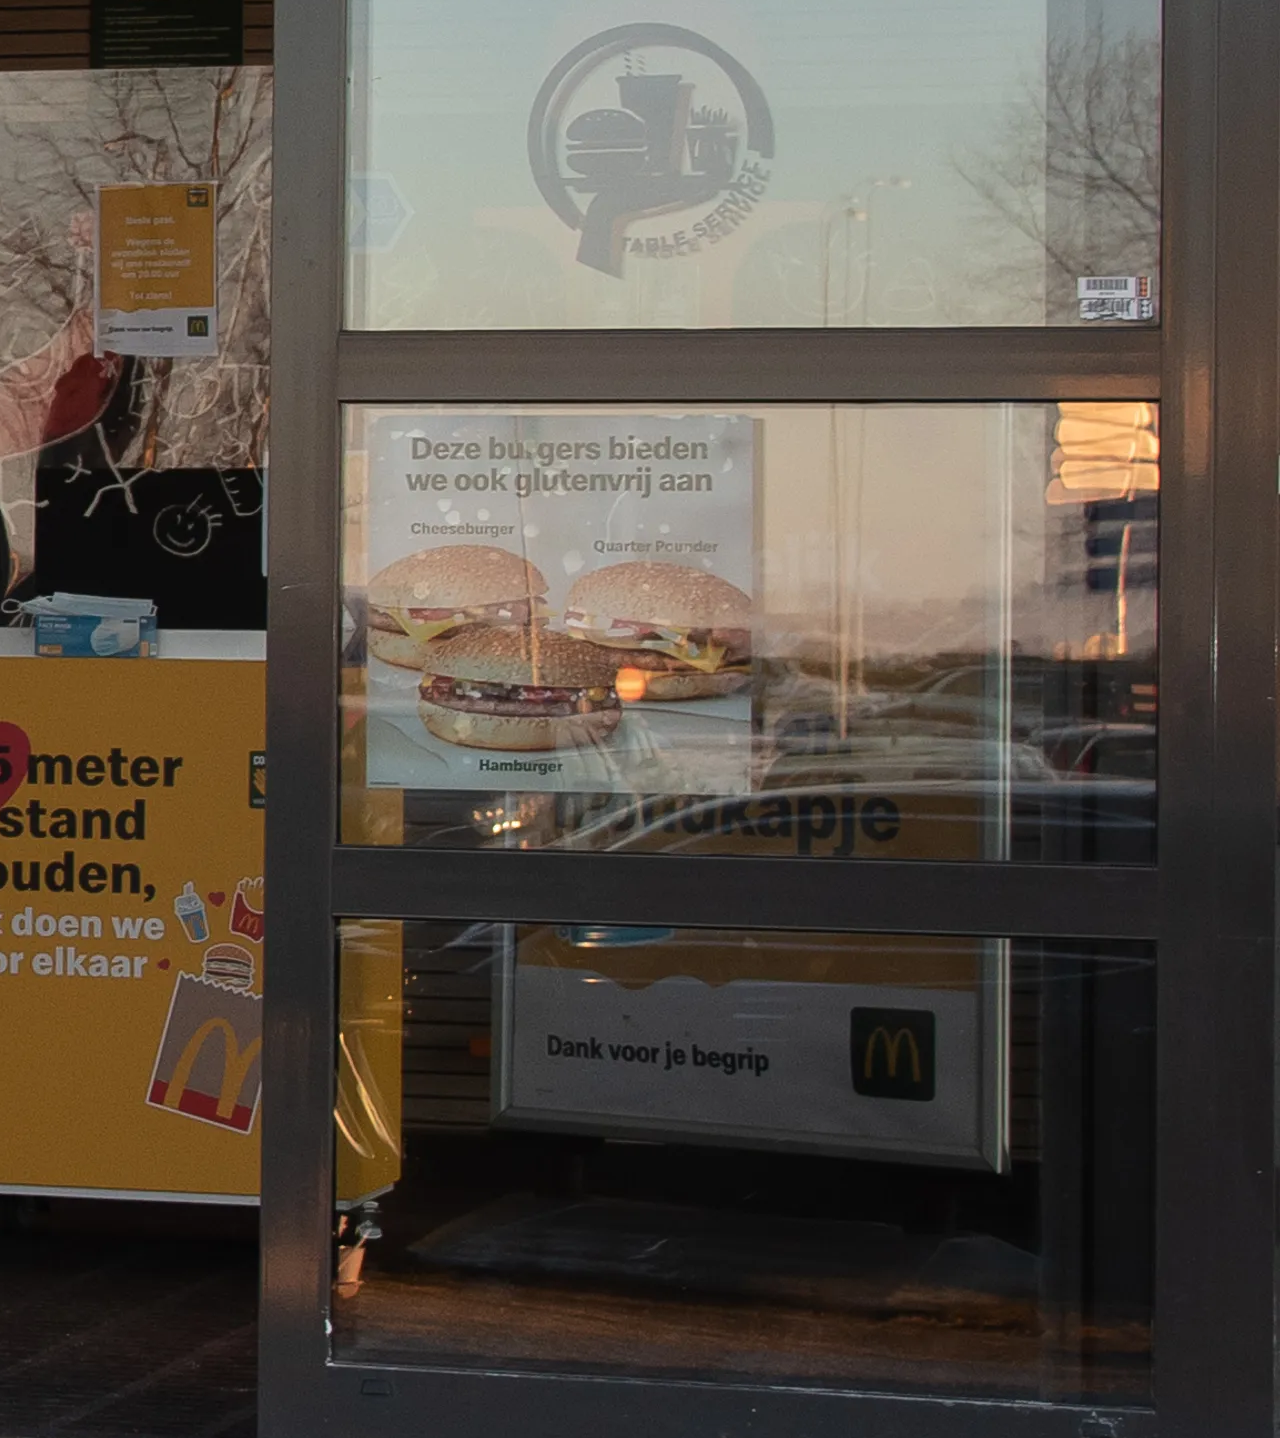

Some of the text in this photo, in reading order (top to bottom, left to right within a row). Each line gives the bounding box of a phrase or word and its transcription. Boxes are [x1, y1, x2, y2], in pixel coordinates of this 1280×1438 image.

[411, 437, 481, 460] Deze
[608, 435, 708, 460] bieden
[406, 467, 713, 498] we ook glutenvrij aan
[410, 521, 515, 537] Cheeseburger
[593, 539, 718, 554] Quarter Pounder
[26, 748, 183, 788] meter
[479, 758, 563, 776] Hamburger
[11, 906, 102, 939] doen
[112, 914, 166, 940] we
[31, 946, 148, 980] elkaar
[547, 1034, 770, 1076] Dank voor je begrip
